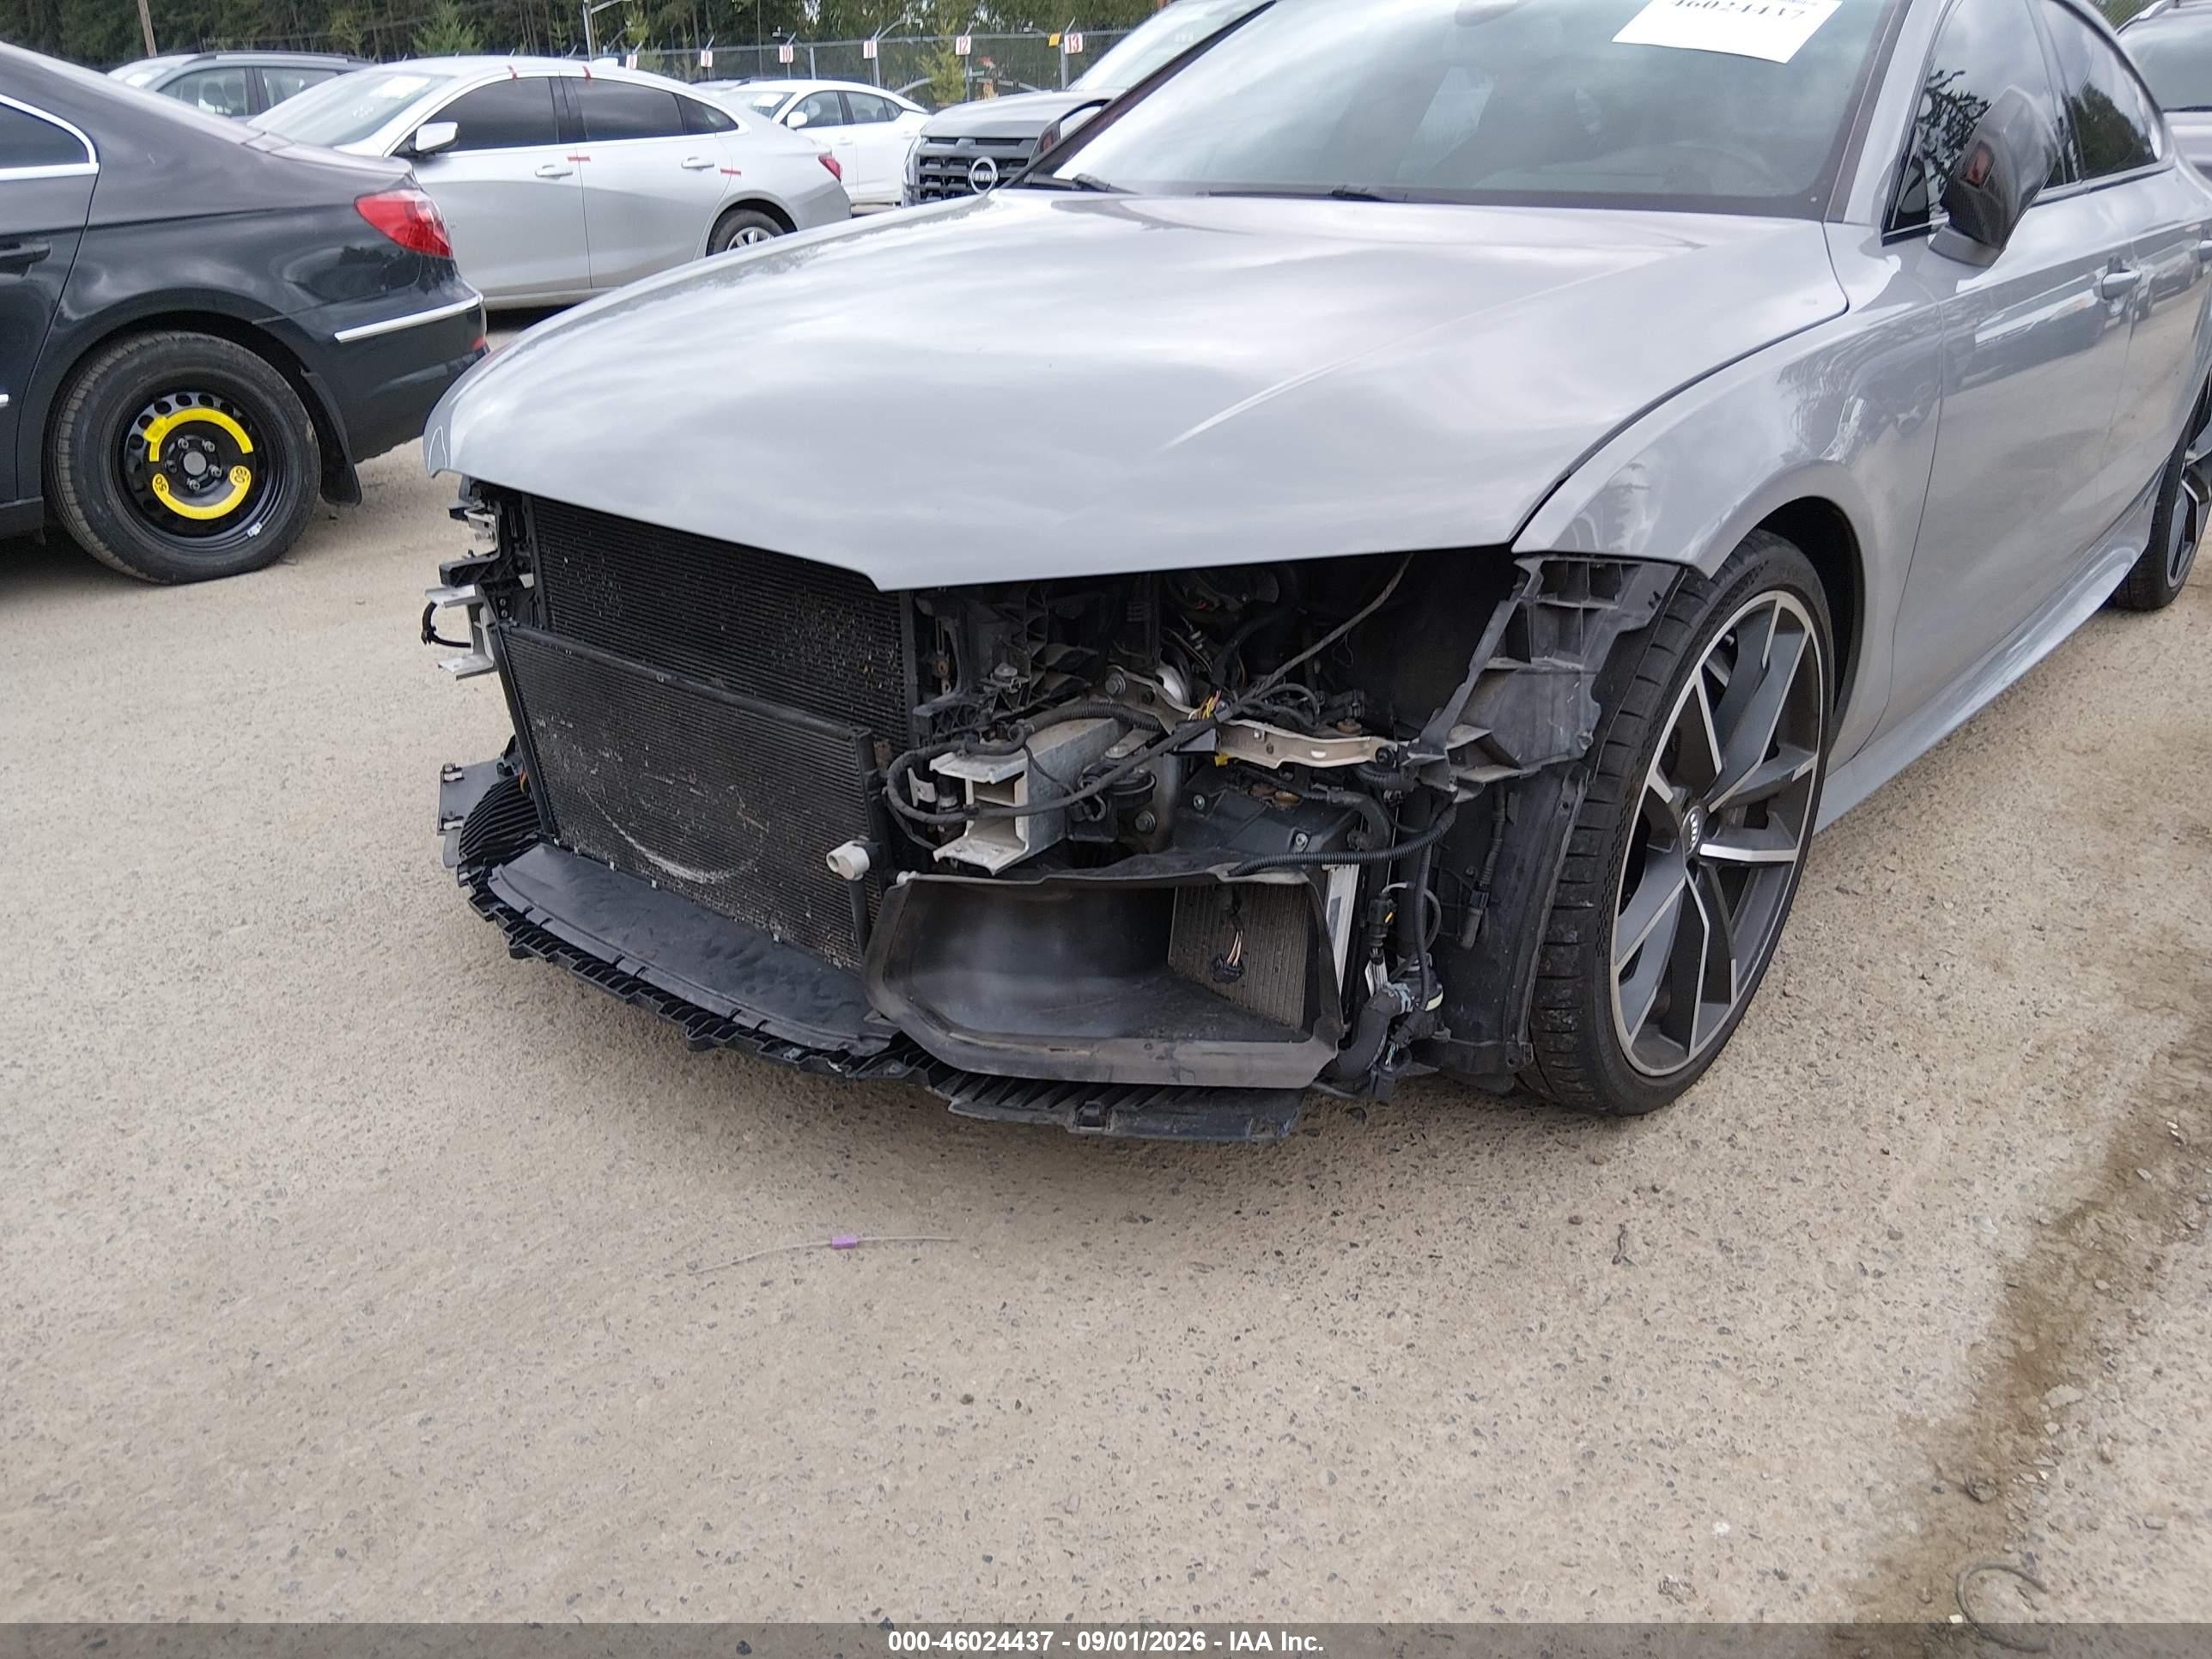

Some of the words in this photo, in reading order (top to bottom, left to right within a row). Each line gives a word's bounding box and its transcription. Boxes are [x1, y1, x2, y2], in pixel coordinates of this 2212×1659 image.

[958, 37, 969, 54] 12
[1068, 35, 1079, 52] 13
[782, 46, 791, 63] 10
